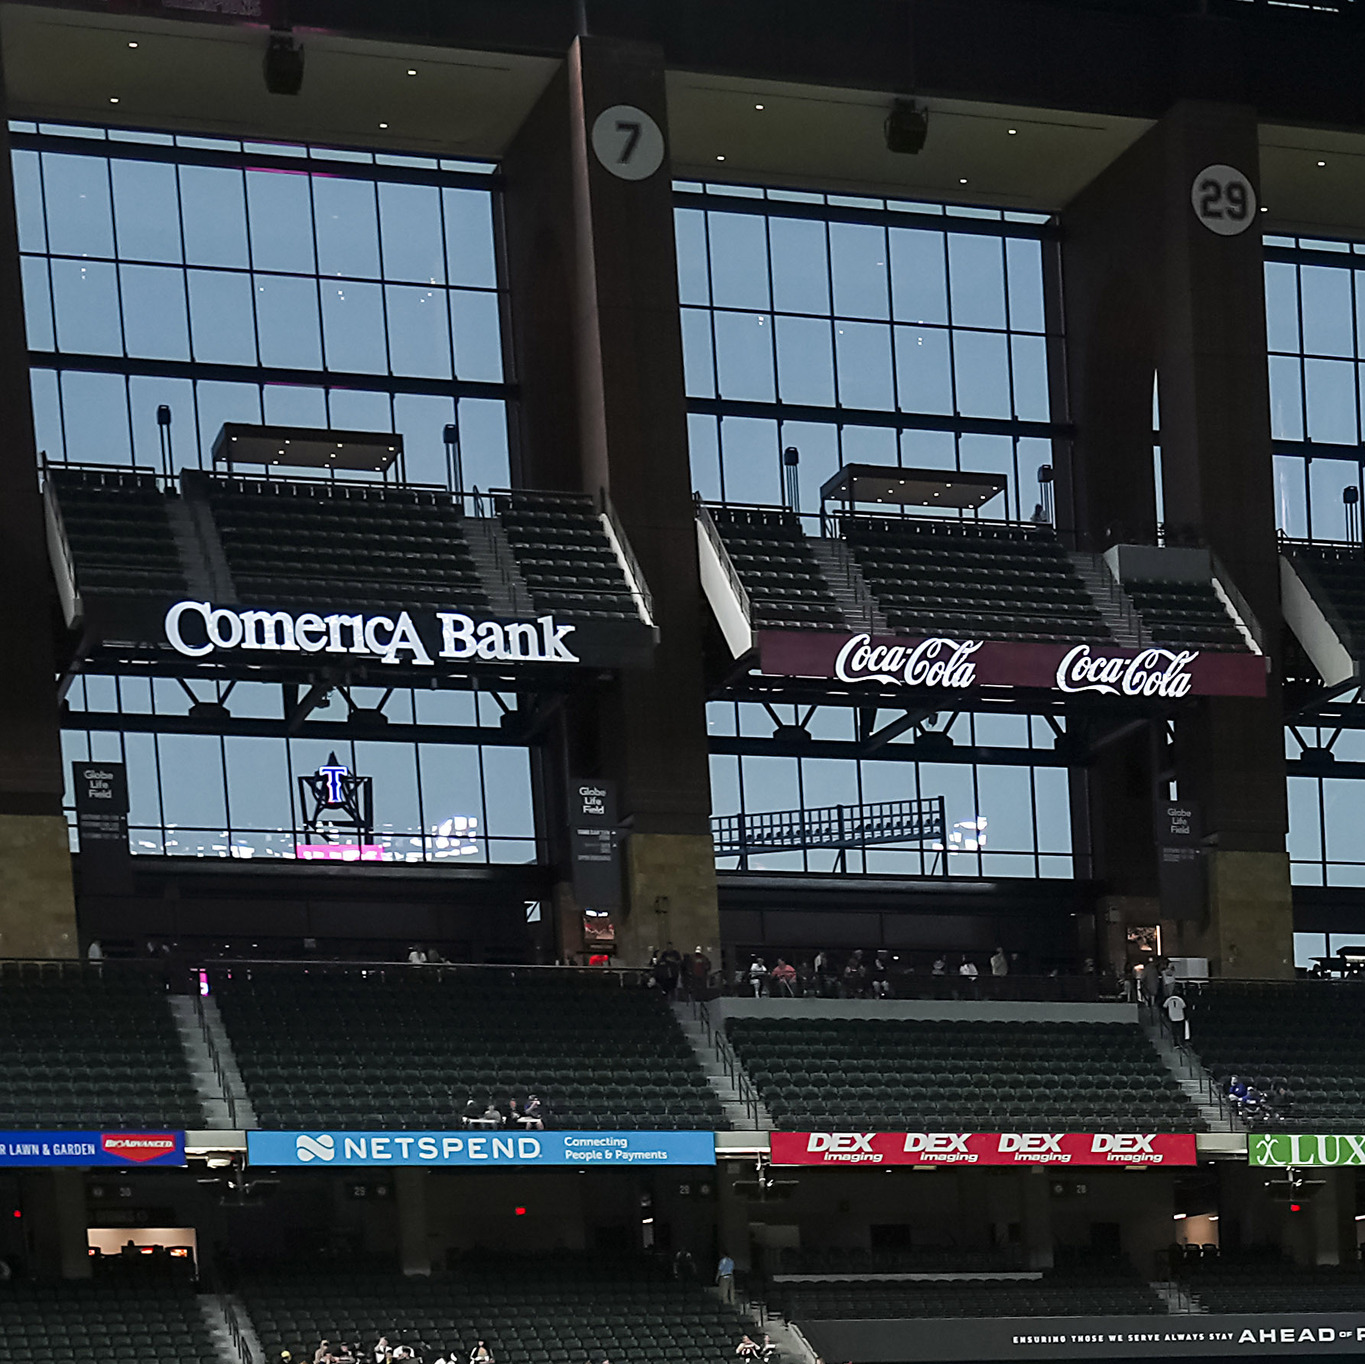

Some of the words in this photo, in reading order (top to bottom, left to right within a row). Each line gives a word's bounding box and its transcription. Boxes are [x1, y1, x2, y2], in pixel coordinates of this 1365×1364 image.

[616, 121, 643, 165] 7
[1199, 181, 1248, 220] 29
[437, 612, 580, 663] Bank
[835, 633, 984, 689] Coca-Cola
[1056, 644, 1200, 698] Coca-Cola
[84, 769, 114, 781] Globe
[579, 786, 606, 798] Globe
[1167, 807, 1192, 819] Globe
[9, 1144, 39, 1155] LAWN
[42, 1144, 50, 1155] &
[53, 1144, 95, 1155] GARDEN
[344, 1136, 540, 1159] NETSPEND
[564, 1136, 628, 1150] Connecting
[807, 1133, 877, 1152] DEX
[903, 1133, 973, 1152] DEX
[999, 1133, 1067, 1152] DEX
[1091, 1133, 1157, 1152] DEX
[565, 1149, 603, 1162] People
[606, 1149, 614, 1160] &
[616, 1149, 667, 1162] Payments
[824, 1151, 883, 1163] imaging
[920, 1151, 979, 1163] imaging
[1014, 1151, 1072, 1163] imaging
[1106, 1151, 1163, 1163] imaging
[1013, 1335, 1066, 1344] ENSURING
[1071, 1335, 1104, 1344] THOSE
[1109, 1334, 1123, 1343] WE
[1127, 1334, 1160, 1342] SERVE
[1164, 1333, 1205, 1342] ALWAYS
[1209, 1333, 1234, 1341] STAY
[1238, 1327, 1336, 1343] AHEAD
